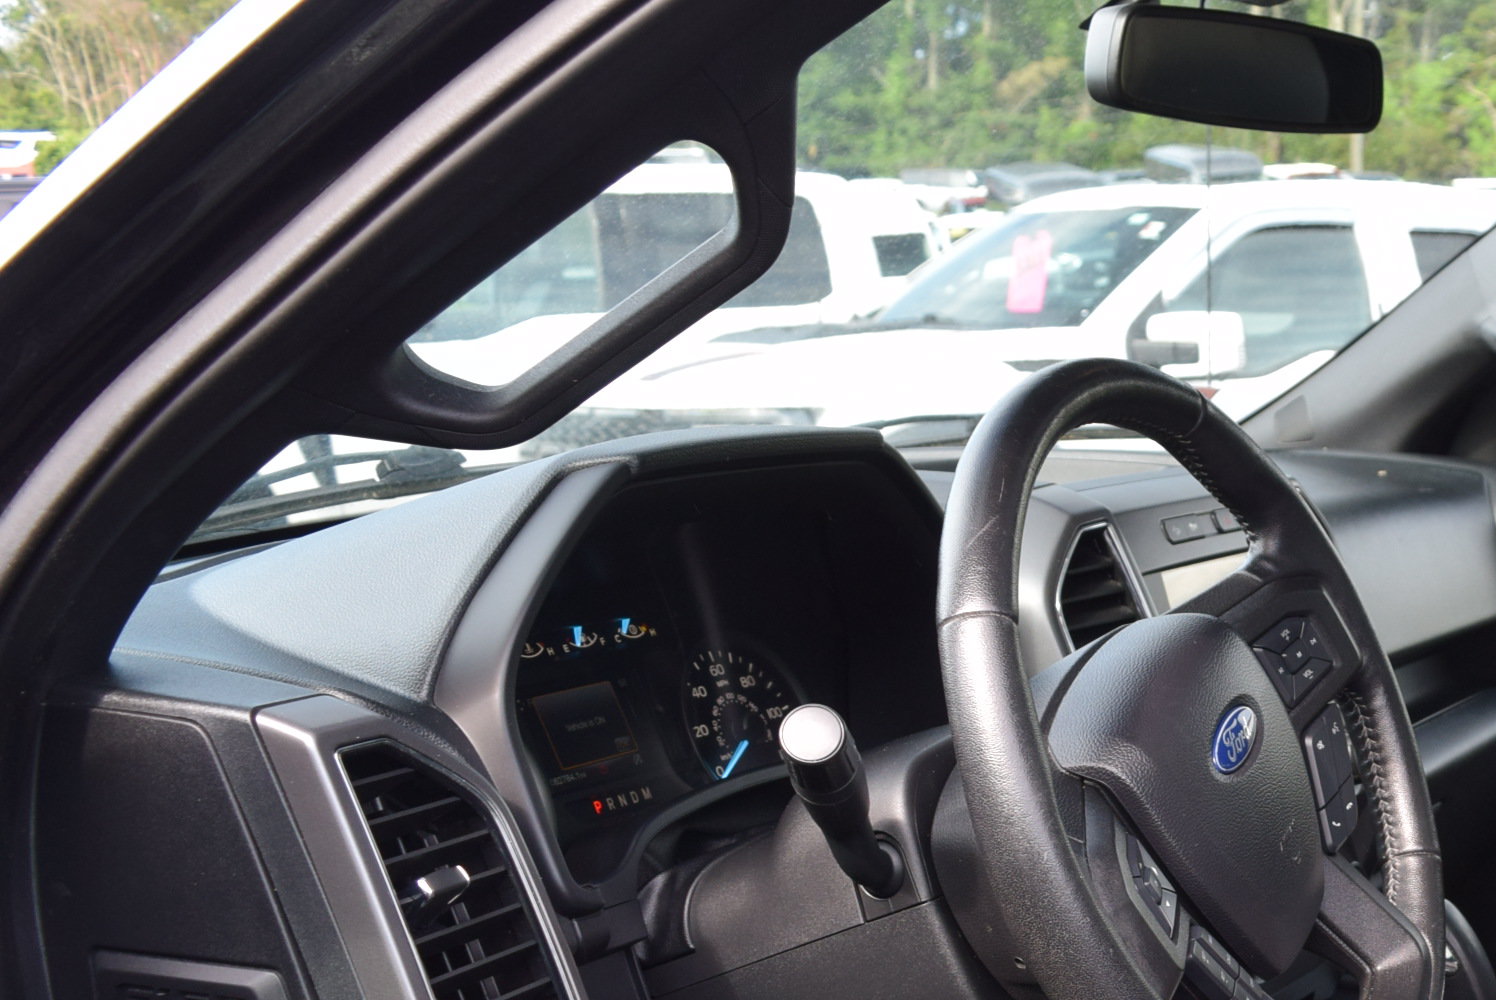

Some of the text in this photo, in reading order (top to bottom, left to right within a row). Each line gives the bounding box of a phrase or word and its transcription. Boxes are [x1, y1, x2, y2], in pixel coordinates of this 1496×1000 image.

[708, 663, 725, 677] 60
[739, 674, 756, 689] 80
[691, 685, 708, 699] 40
[766, 707, 783, 720] 100
[693, 724, 709, 739] 20
[715, 765, 724, 778] 0
